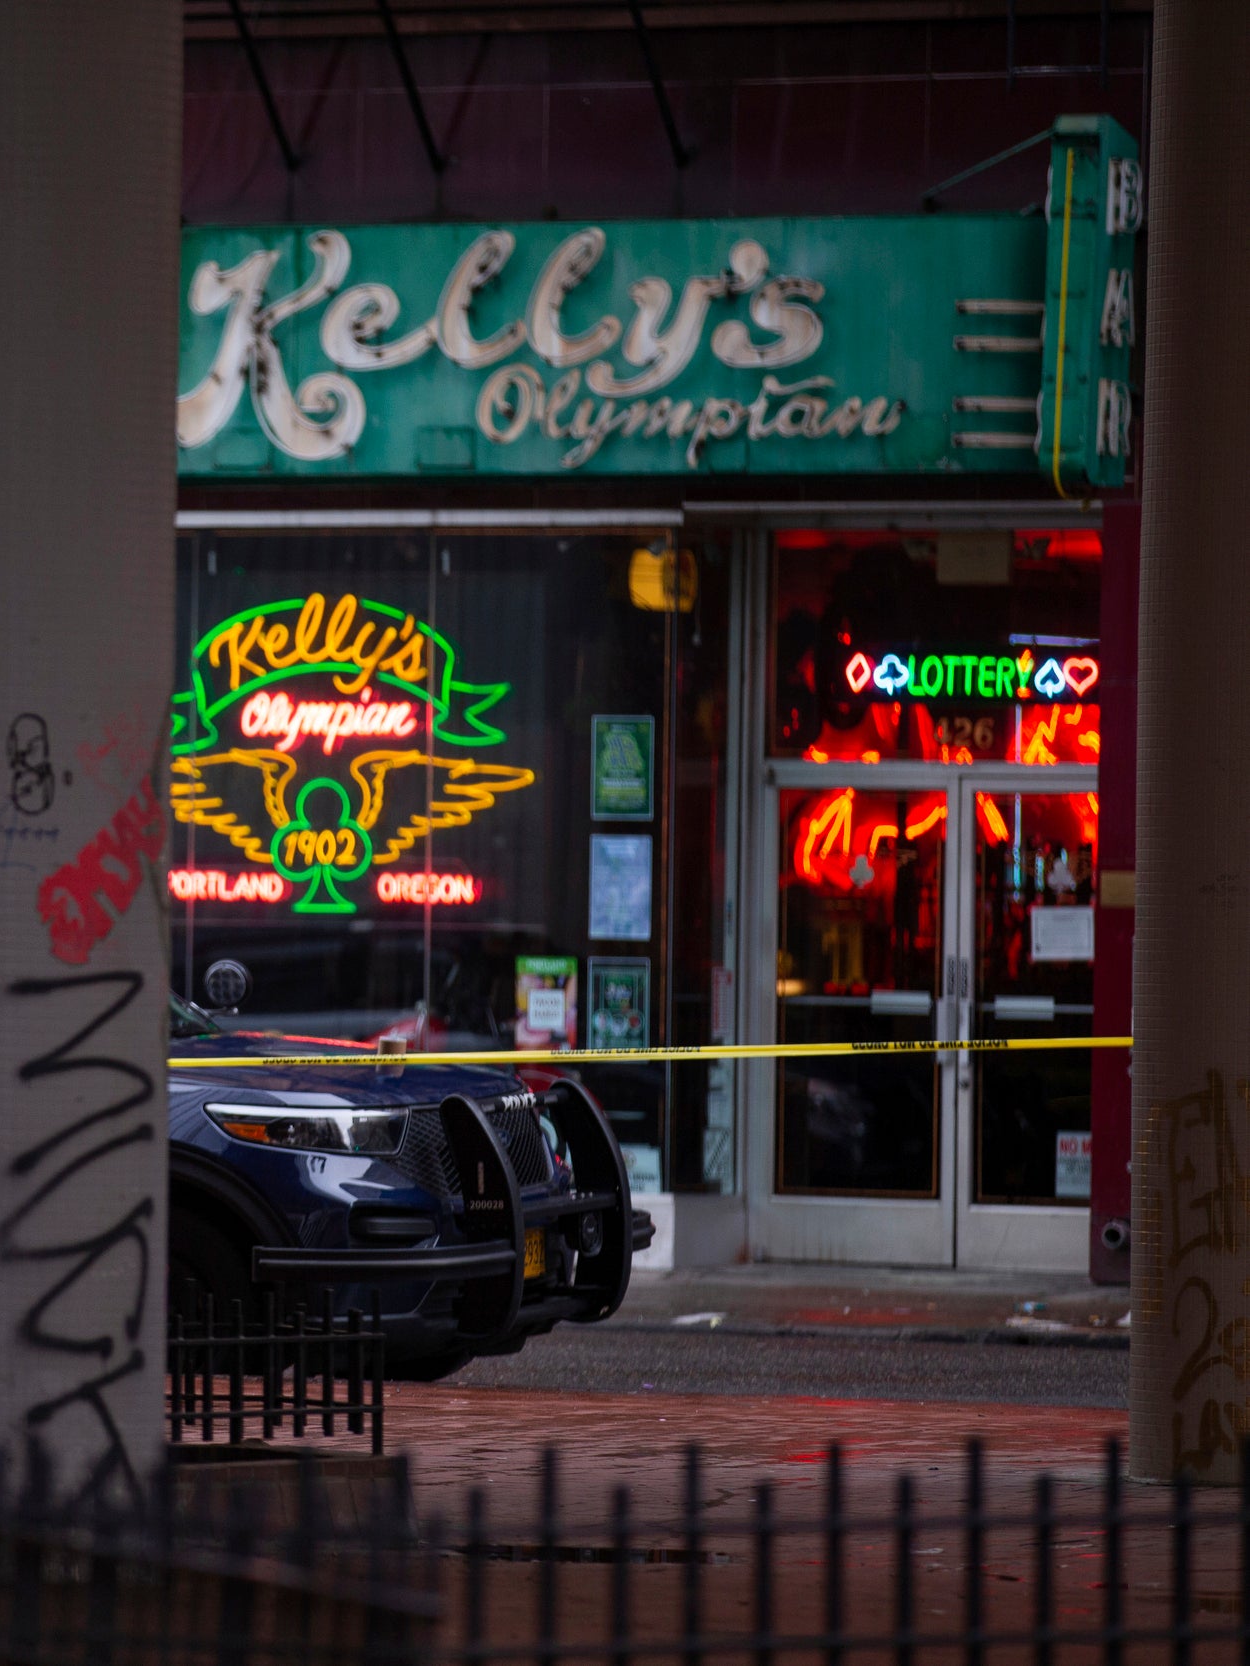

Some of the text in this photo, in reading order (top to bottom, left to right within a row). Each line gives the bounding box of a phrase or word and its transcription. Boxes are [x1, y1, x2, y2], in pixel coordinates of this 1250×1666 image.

[178, 227, 825, 461] Kelly's
[476, 362, 907, 469] Olympian
[209, 592, 428, 695] Kelly's
[907, 653, 1034, 698] LOTTERY
[240, 686, 418, 755] Olympian
[285, 829, 357, 866] 1902
[376, 871, 476, 904] OREGON
[470, 1200, 504, 1210] 200028
